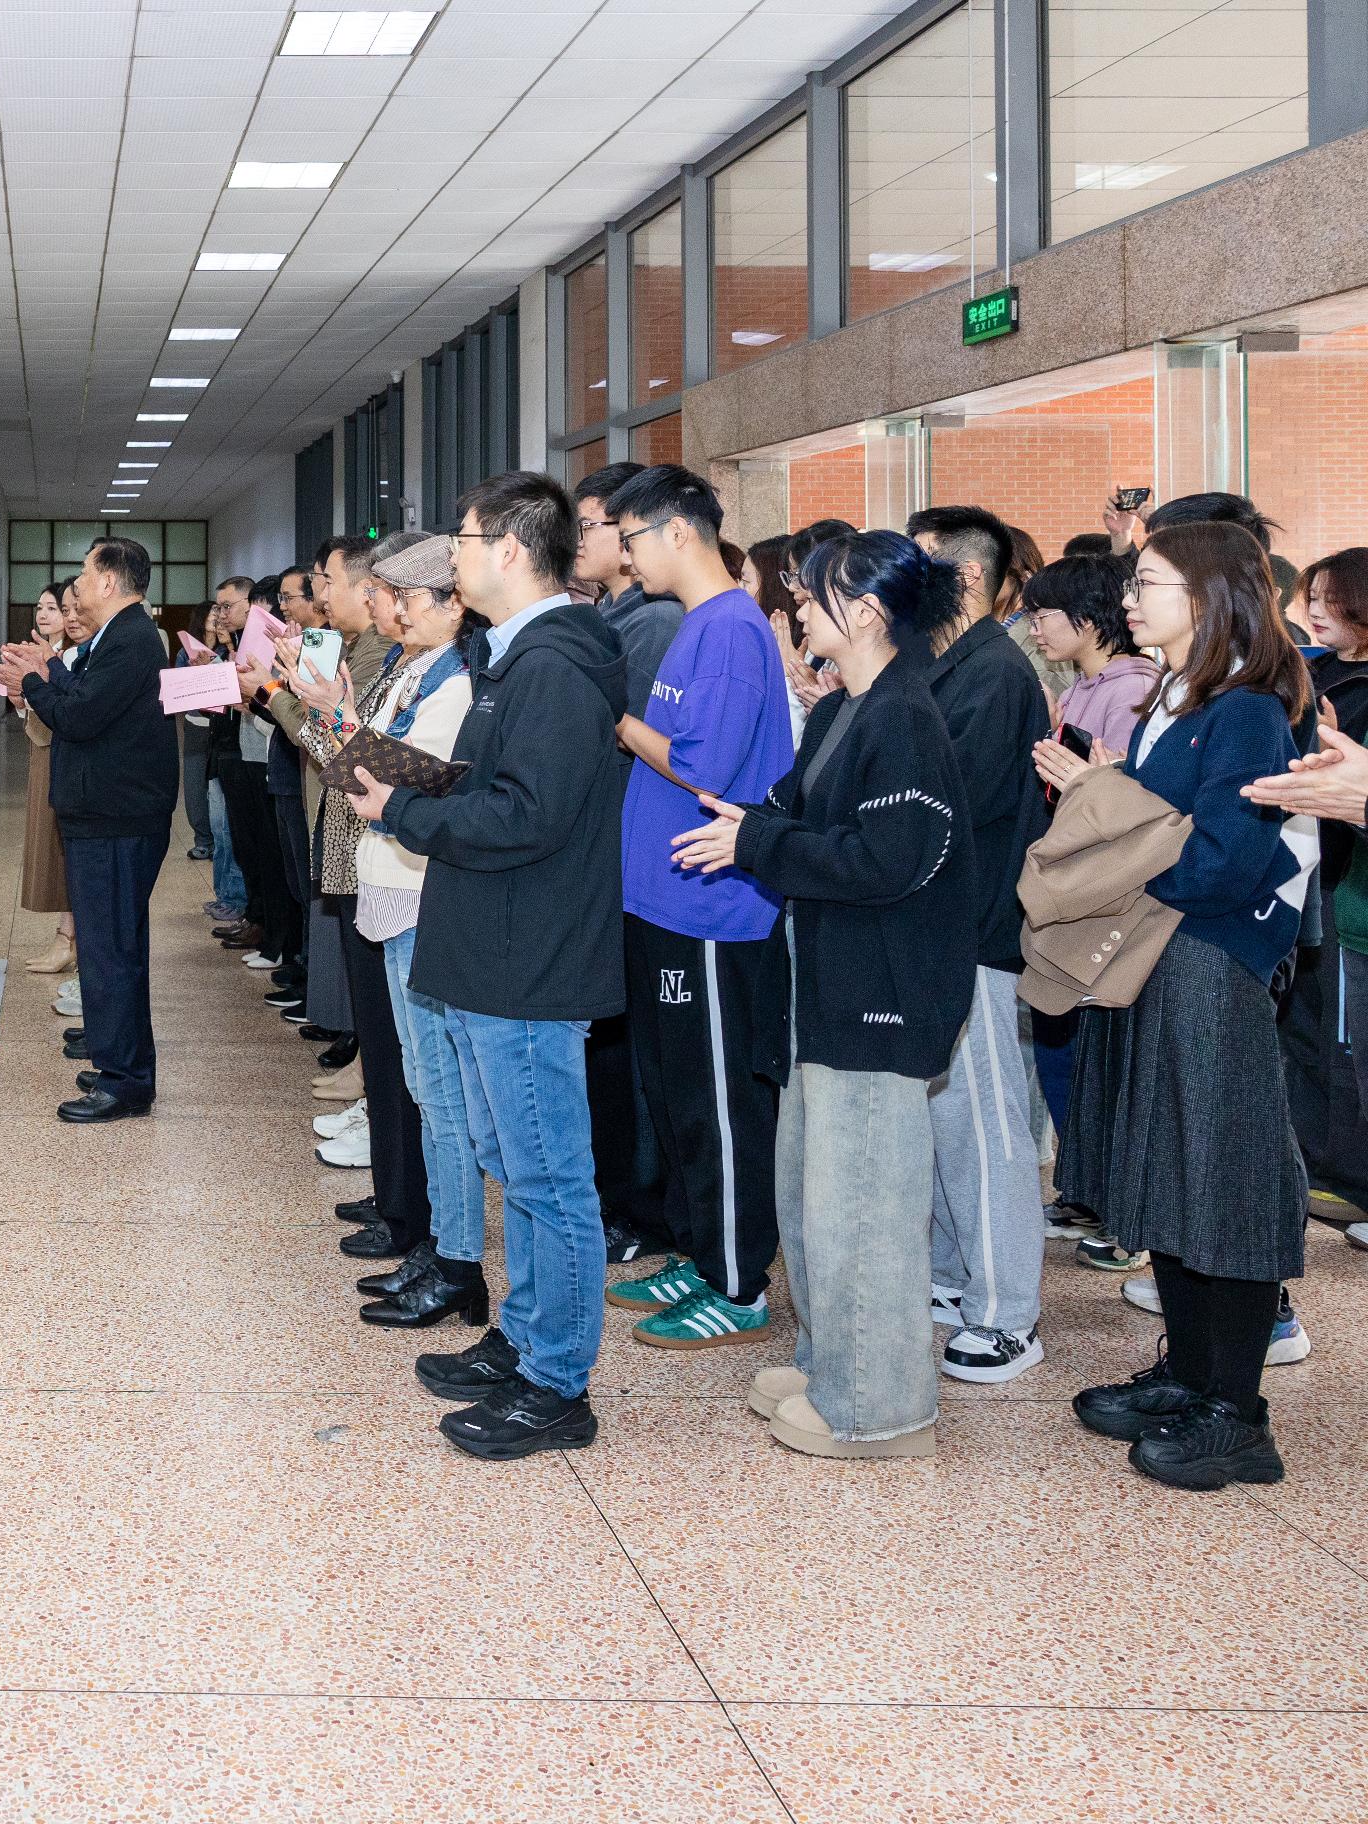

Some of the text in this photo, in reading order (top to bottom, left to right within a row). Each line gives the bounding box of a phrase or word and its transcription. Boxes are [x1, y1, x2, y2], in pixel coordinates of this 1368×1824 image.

[968, 298, 1005, 325] 安全出口
[975, 317, 998, 333] EXIT
